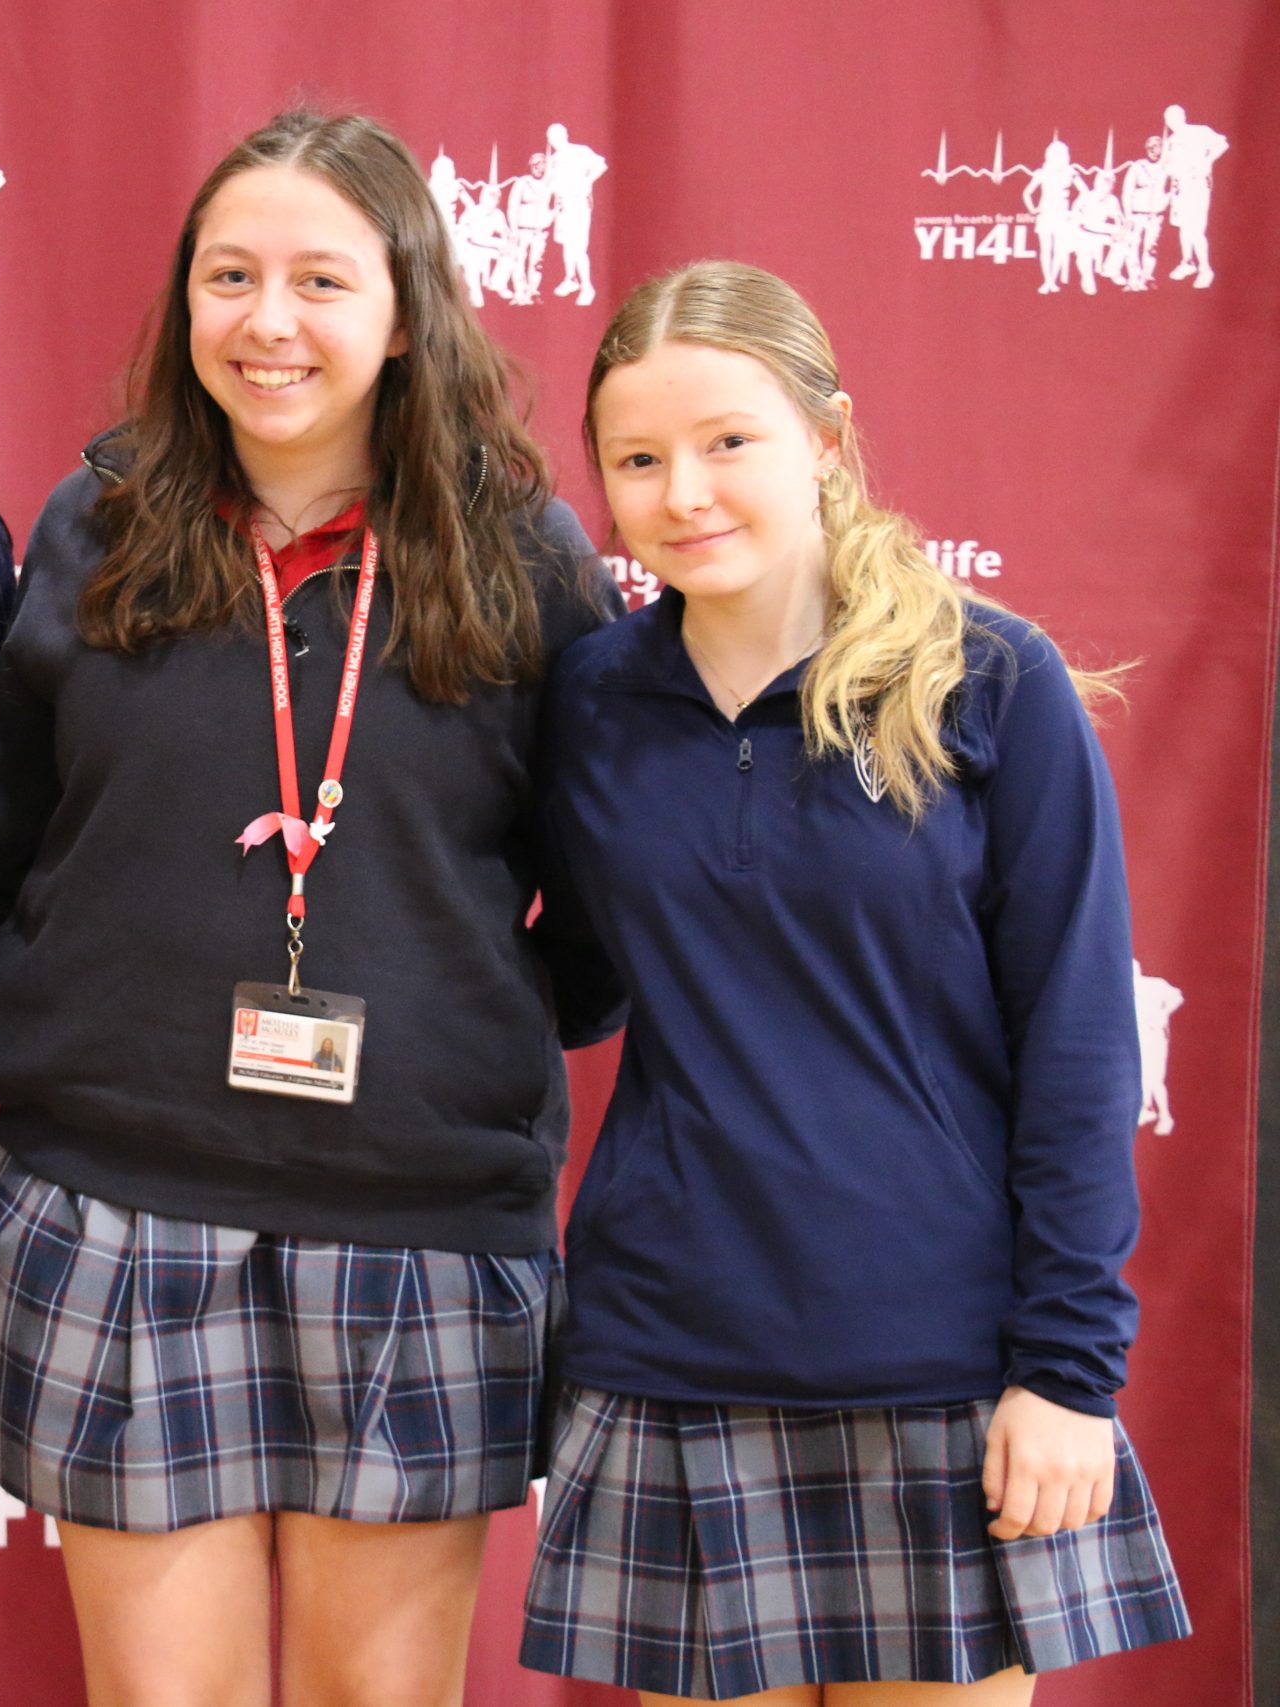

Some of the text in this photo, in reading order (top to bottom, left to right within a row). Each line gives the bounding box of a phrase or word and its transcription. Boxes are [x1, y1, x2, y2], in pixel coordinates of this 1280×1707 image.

[914, 223, 1038, 264] YH4L
[364, 549, 378, 577] ARTS
[925, 539, 1003, 578] life
[261, 566, 279, 607] LIBERAL
[357, 578, 375, 619] LIBERAL
[268, 607, 282, 634] ARTS
[271, 636, 284, 663] HIGH
[273, 665, 288, 711] SCHOOL
[338, 671, 358, 717] MOTHER
